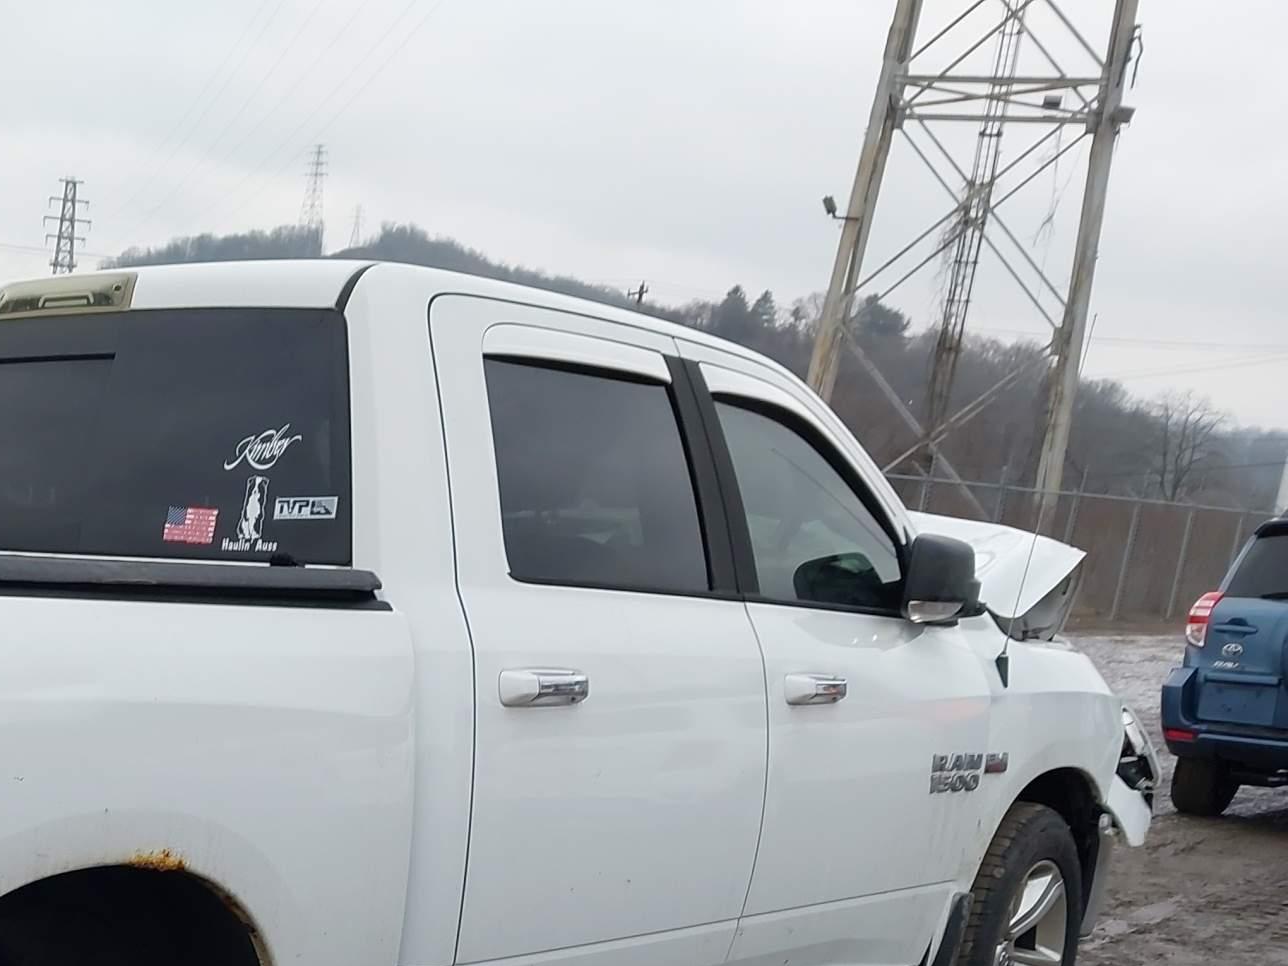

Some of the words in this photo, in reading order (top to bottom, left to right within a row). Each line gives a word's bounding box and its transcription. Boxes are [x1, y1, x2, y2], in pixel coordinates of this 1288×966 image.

[223, 422, 303, 470] Kimber
[254, 538, 278, 552] Auss
[931, 752, 983, 772] RAM
[929, 772, 980, 794] 1500
